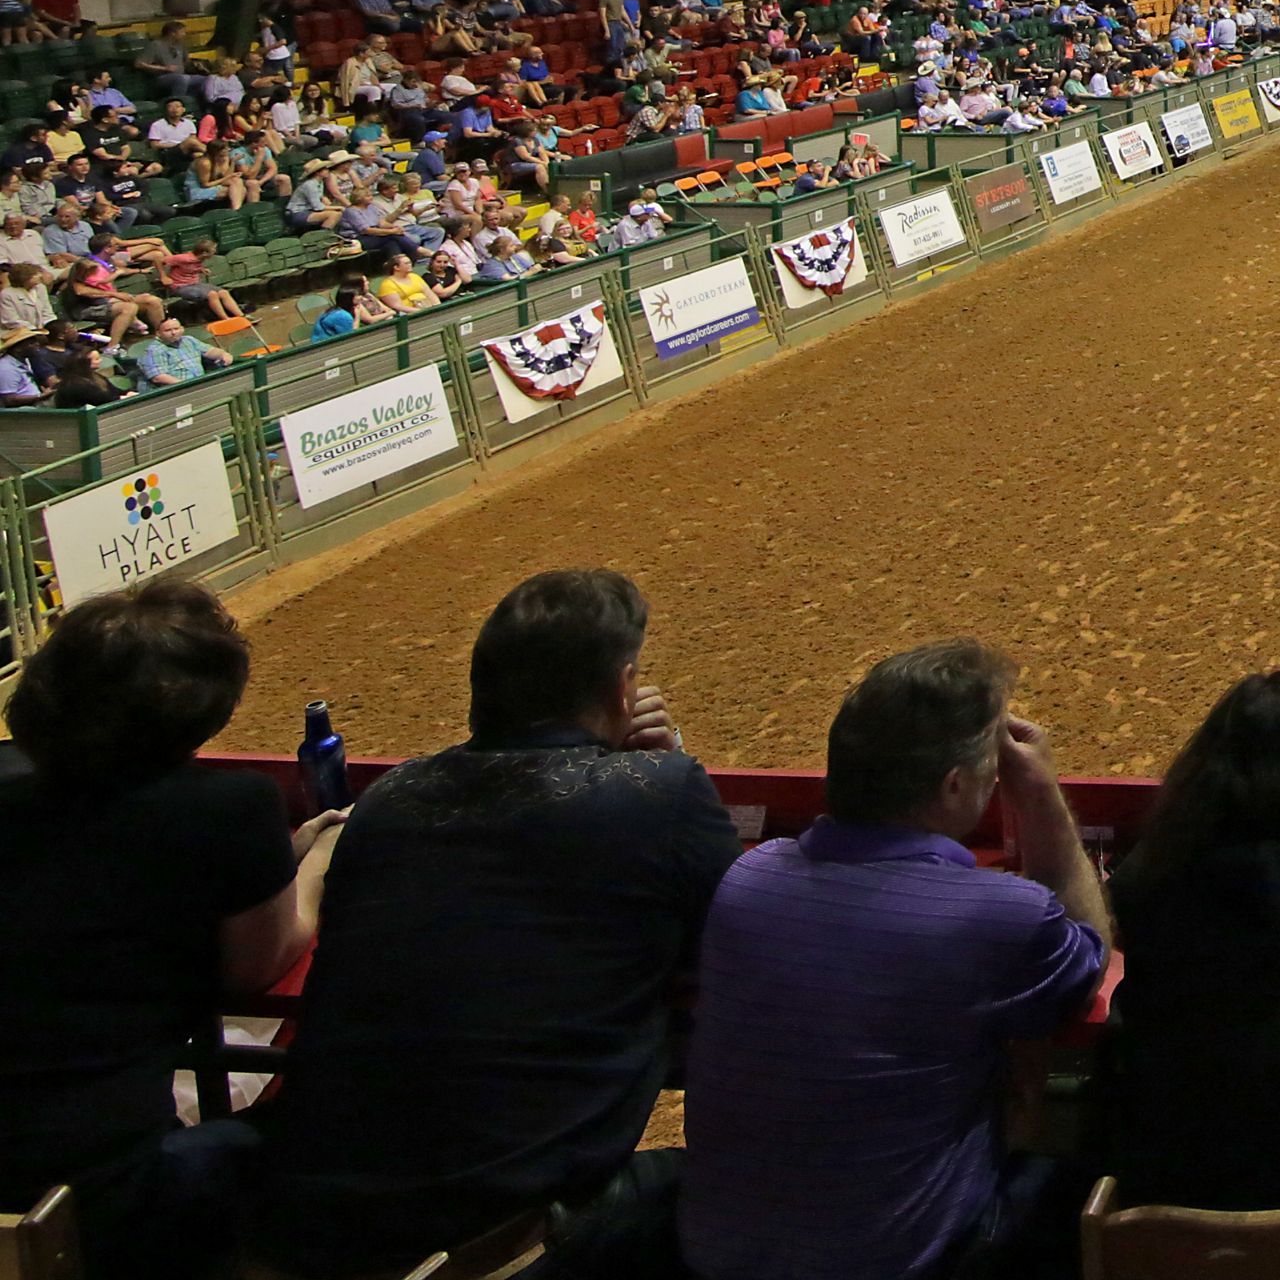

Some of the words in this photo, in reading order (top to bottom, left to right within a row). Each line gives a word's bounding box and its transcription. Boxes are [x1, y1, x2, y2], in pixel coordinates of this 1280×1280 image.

[975, 178, 1026, 208] STETSON
[897, 203, 941, 234] Radisson
[675, 289, 716, 311] GAYLORD
[716, 278, 746, 295] TEXAN
[667, 312, 750, 349] www.gaylordcareers.com
[300, 415, 370, 456] Brazos
[371, 392, 434, 426] Valley
[311, 419, 406, 464] equipment
[410, 412, 434, 426] co.
[321, 427, 433, 477] www.brazosvalleyeq.com
[99, 503, 196, 569] HYATT
[120, 536, 192, 582] PLACE
